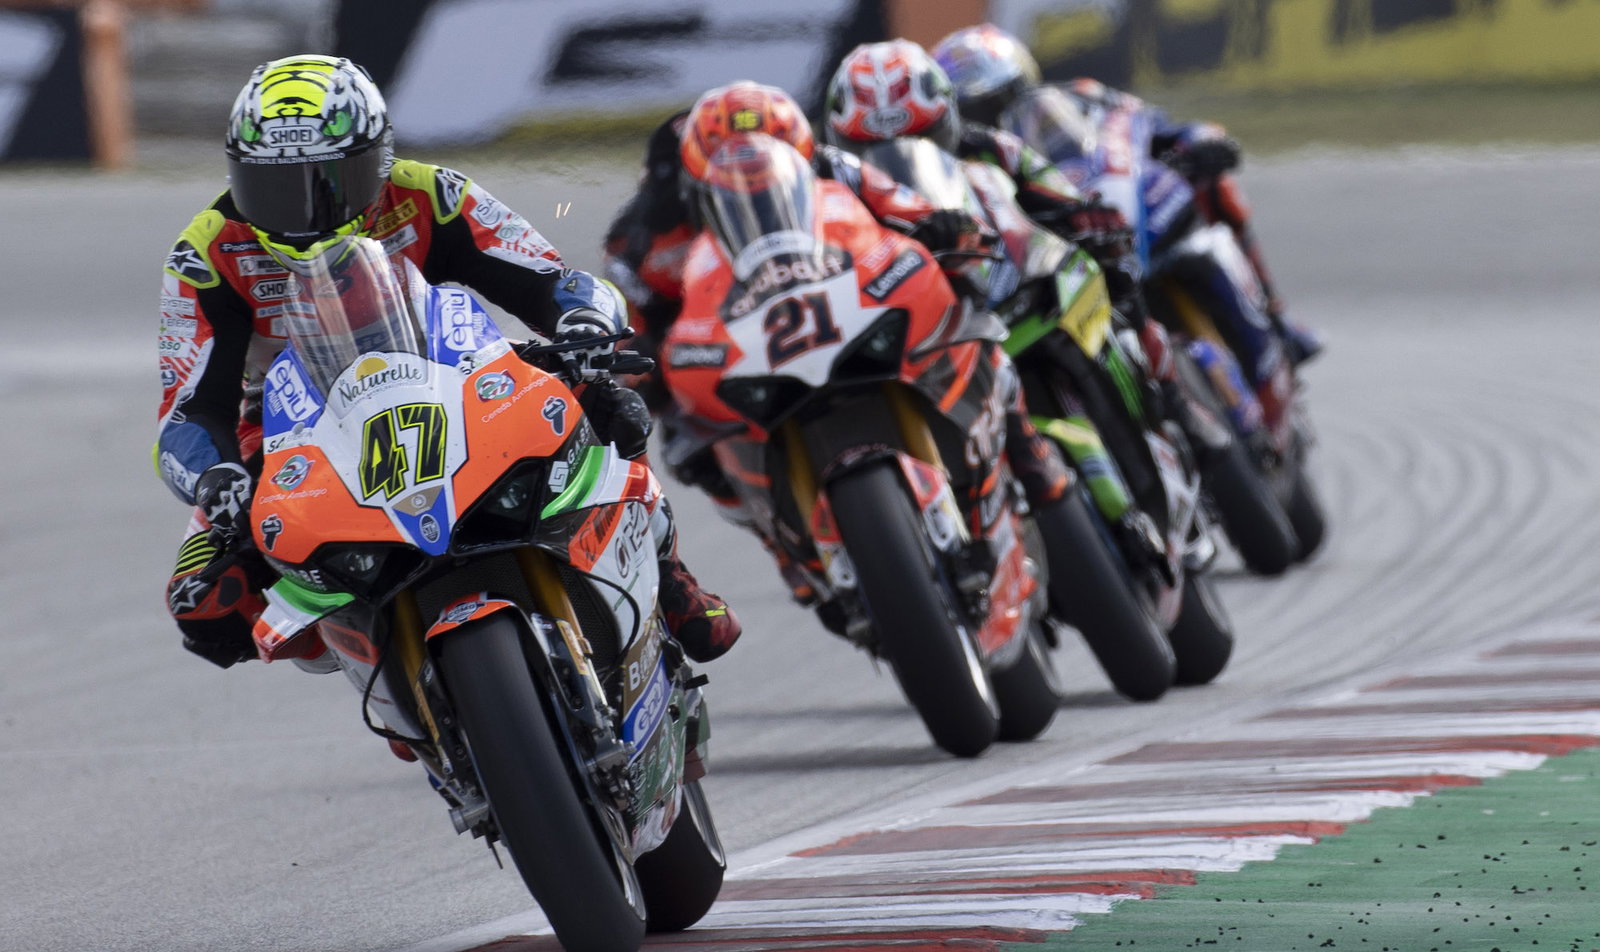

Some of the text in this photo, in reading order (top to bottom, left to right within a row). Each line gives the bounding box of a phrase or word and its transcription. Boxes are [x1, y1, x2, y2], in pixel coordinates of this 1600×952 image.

[269, 130, 312, 144] SHOEI
[308, 152, 346, 162] CORRADO
[866, 250, 923, 299] Lenovo
[763, 291, 844, 372] 21
[338, 363, 422, 408] Naturelle
[513, 375, 549, 403] Ambrogio
[358, 402, 447, 502] 47
